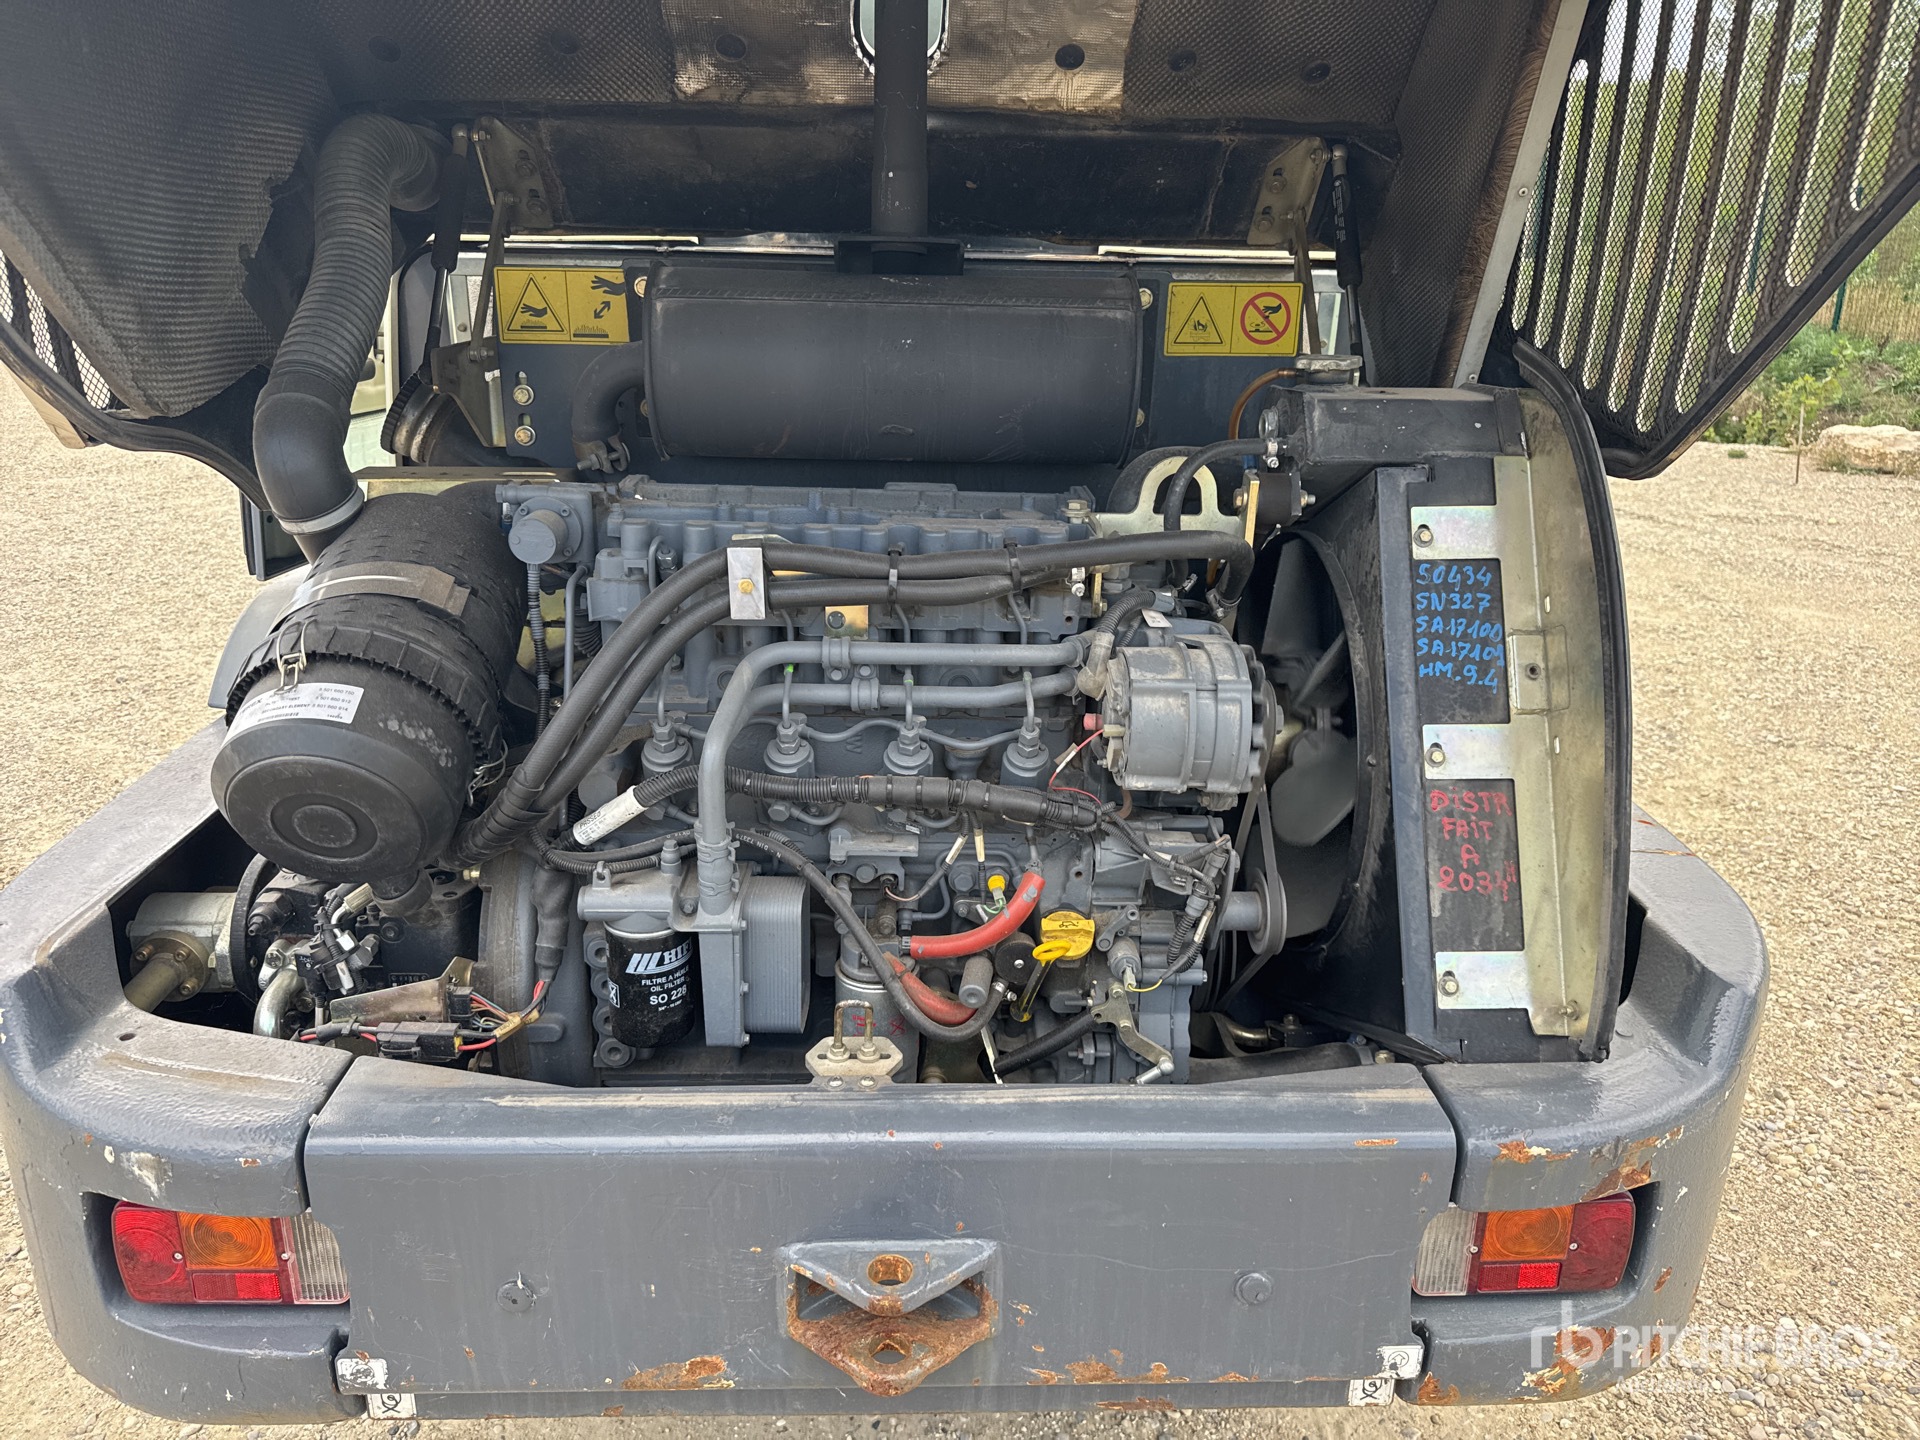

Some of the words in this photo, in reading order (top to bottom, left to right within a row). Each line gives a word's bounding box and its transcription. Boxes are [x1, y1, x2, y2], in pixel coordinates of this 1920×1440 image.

[1461, 844, 1480, 869] A
[641, 976, 667, 987] FILTRE
[664, 976, 685, 990] FILTER
[649, 993, 668, 1005] SO
